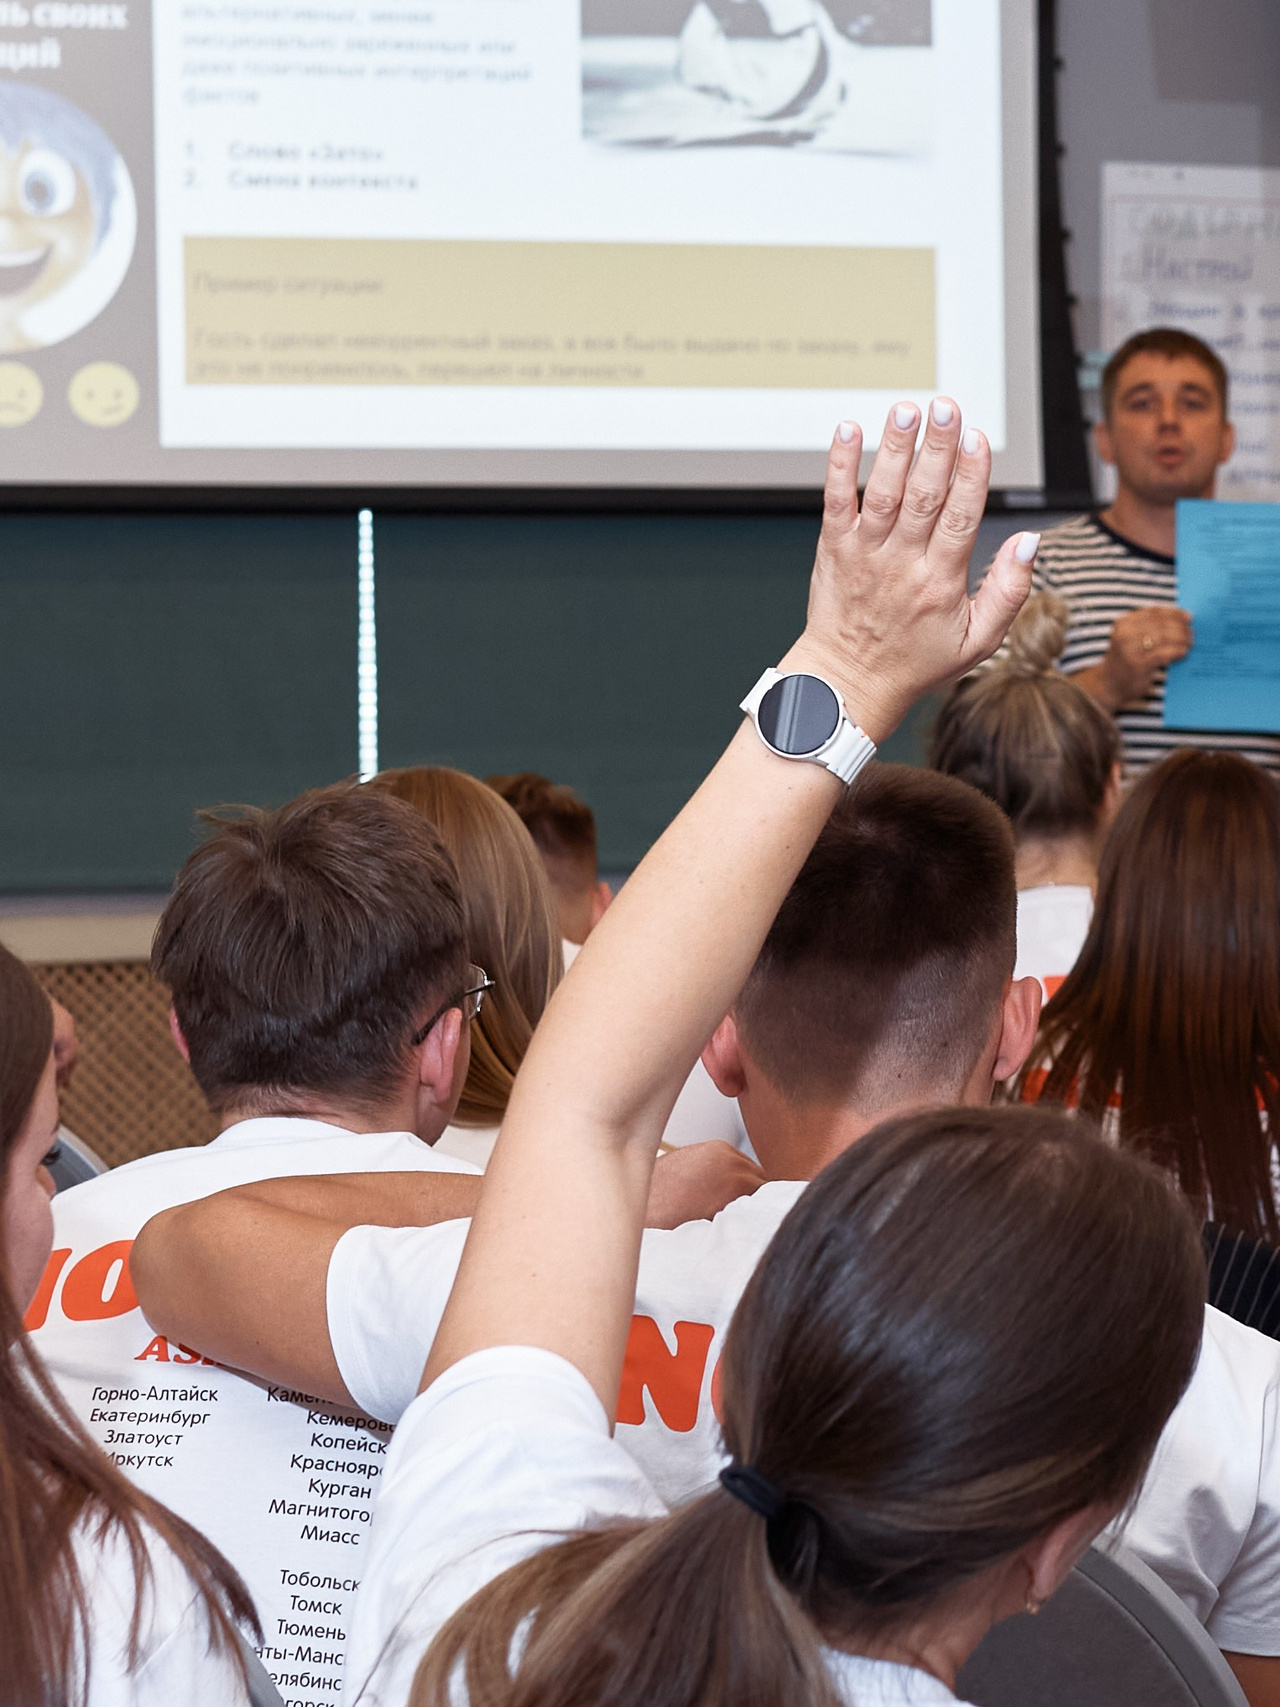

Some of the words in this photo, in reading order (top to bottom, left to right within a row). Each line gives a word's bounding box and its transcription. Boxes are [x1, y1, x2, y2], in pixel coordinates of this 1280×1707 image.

[134, 1335, 225, 1366] AS
[616, 1314, 725, 1432] N
[91, 1385, 219, 1404] Горно-Алтайск
[266, 1386, 334, 1404] Каме
[90, 1408, 211, 1428] Екатеринбург
[104, 1429, 184, 1448] Златоуст
[310, 1433, 388, 1455] Копейск
[308, 1478, 372, 1499] Курган
[268, 1499, 374, 1527] Магнитого
[300, 1525, 361, 1545] Миасс
[280, 1569, 361, 1592] Тобольск
[290, 1595, 342, 1615] Томск
[277, 1619, 347, 1641] Тюмень
[253, 1645, 345, 1666] нты-Манс
